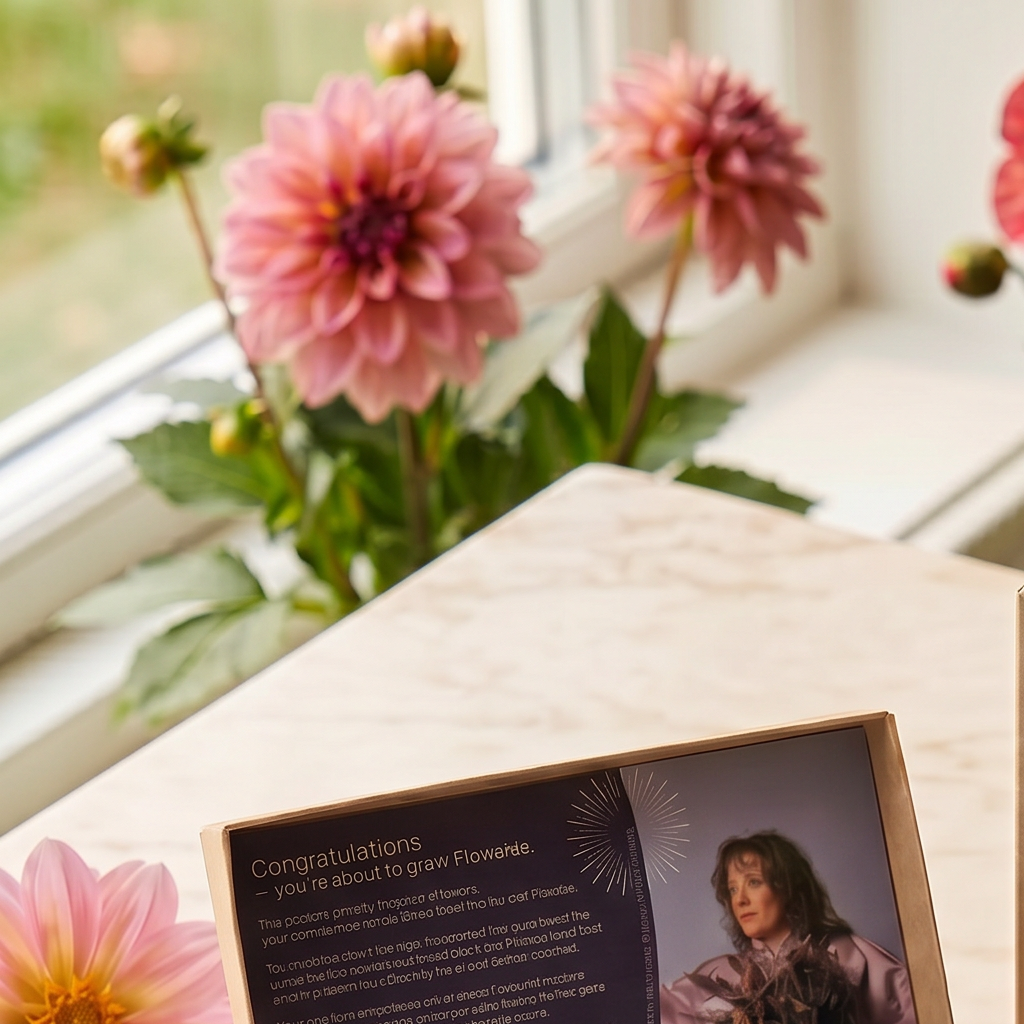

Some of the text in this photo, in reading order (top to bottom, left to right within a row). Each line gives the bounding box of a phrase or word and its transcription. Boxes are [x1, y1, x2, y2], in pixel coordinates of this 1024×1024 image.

[251, 836, 422, 878] Congratulations
[274, 873, 328, 901] you're
[331, 865, 382, 888] about
[384, 863, 403, 878] to
[406, 855, 449, 878] graw
